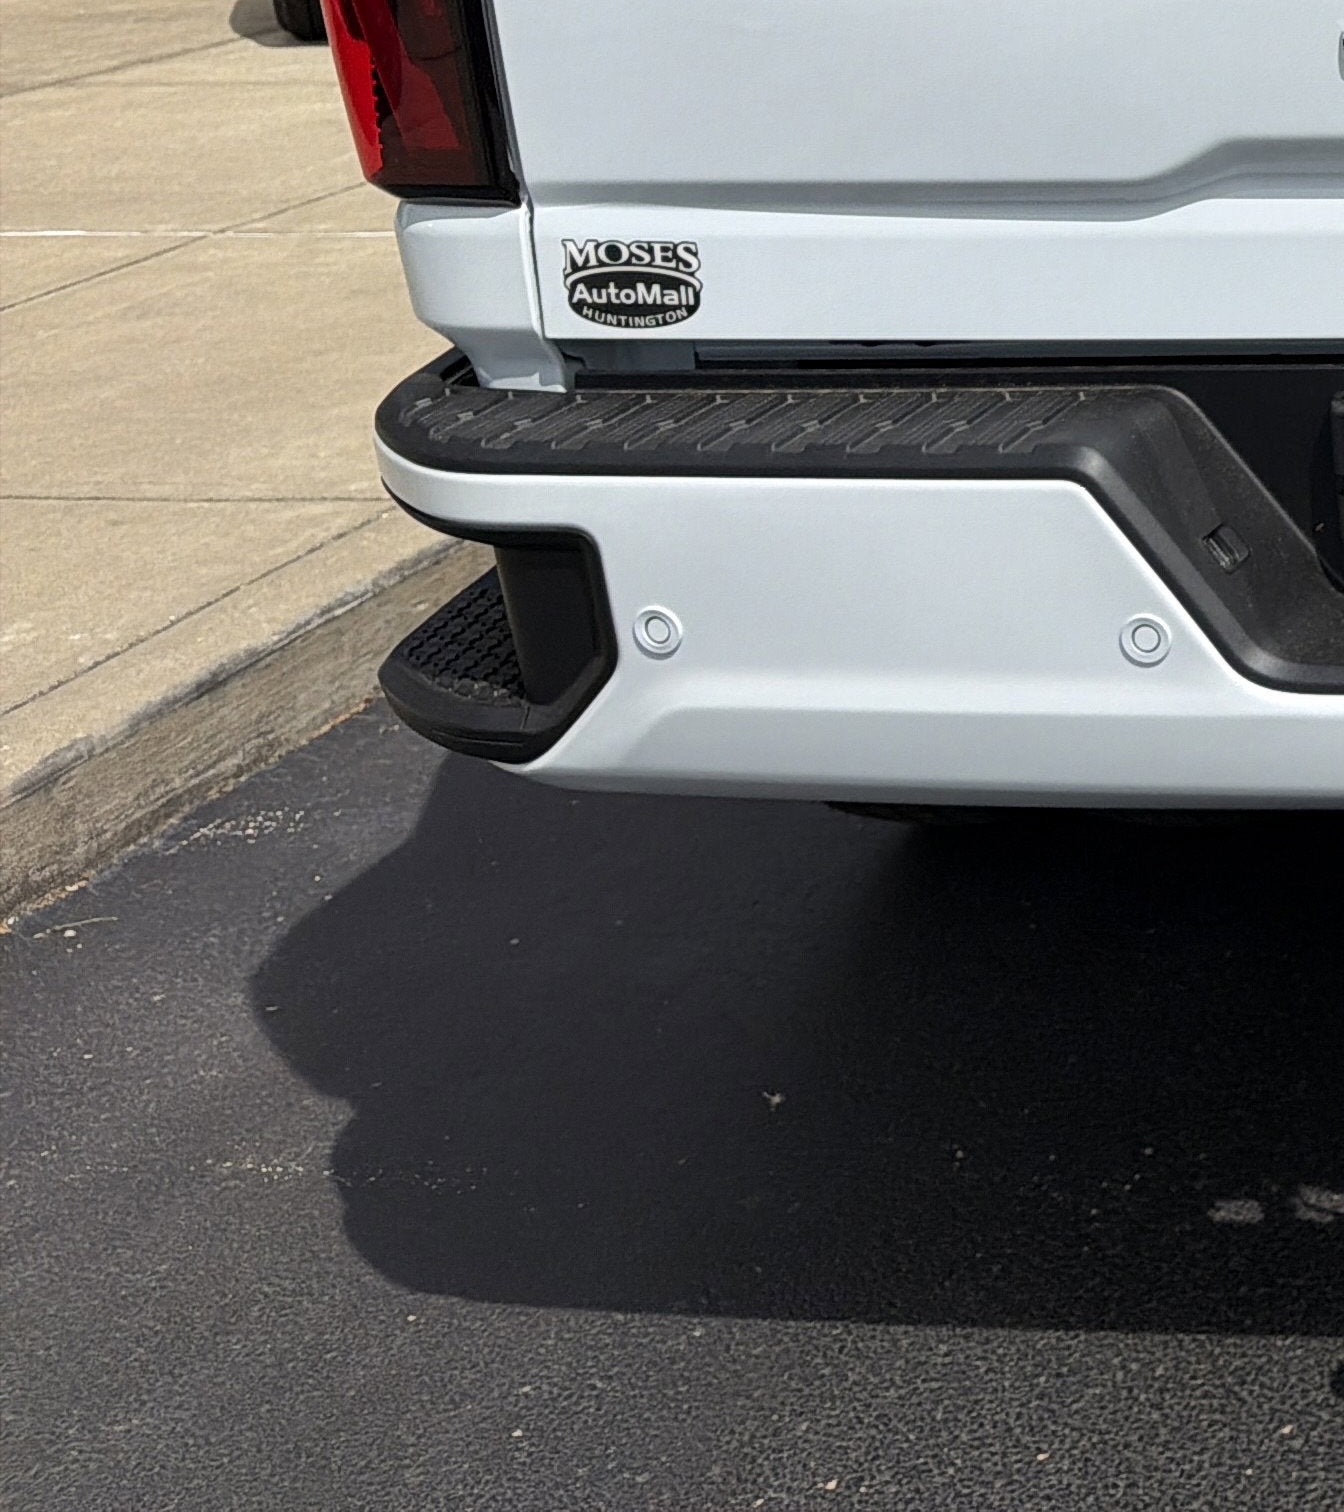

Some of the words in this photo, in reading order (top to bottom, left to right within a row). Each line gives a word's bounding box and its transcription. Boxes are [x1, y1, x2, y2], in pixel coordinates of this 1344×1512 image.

[562, 238, 701, 275] MOSES
[571, 281, 695, 306] AutoMall
[582, 305, 688, 327] HUNTINGTON
